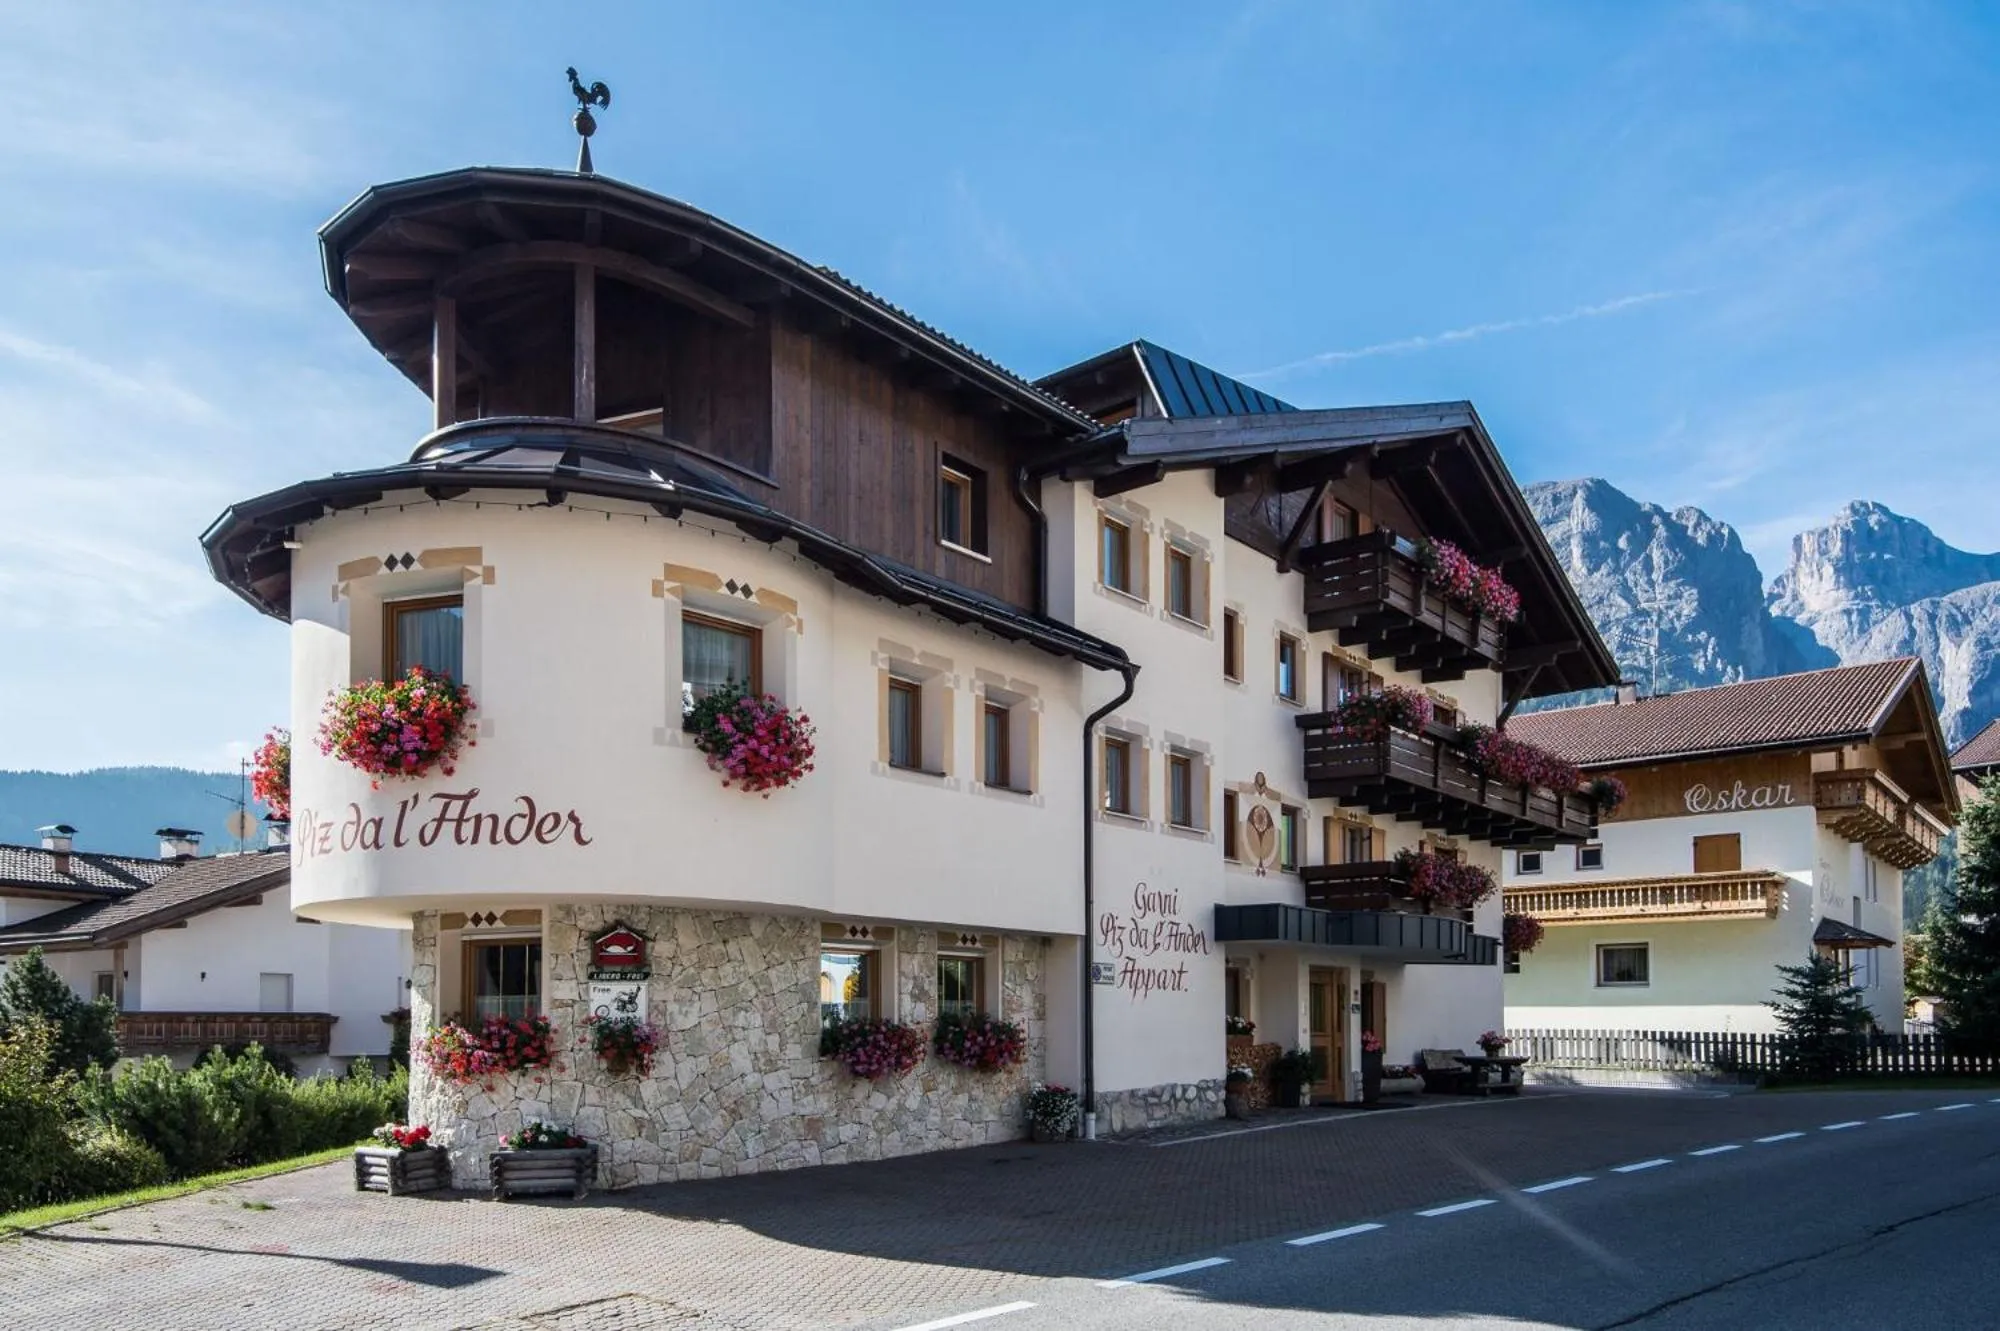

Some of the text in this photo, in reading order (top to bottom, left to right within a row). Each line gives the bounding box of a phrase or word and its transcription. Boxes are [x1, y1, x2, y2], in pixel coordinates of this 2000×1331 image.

[1684, 780, 1795, 813] Oskar
[296, 807, 334, 867] Piz
[340, 802, 385, 851] da
[1132, 882, 1178, 919] Garni
[1097, 912, 1126, 958] Piz
[1129, 917, 1149, 950] da
[1117, 956, 1188, 1004] Appart.
